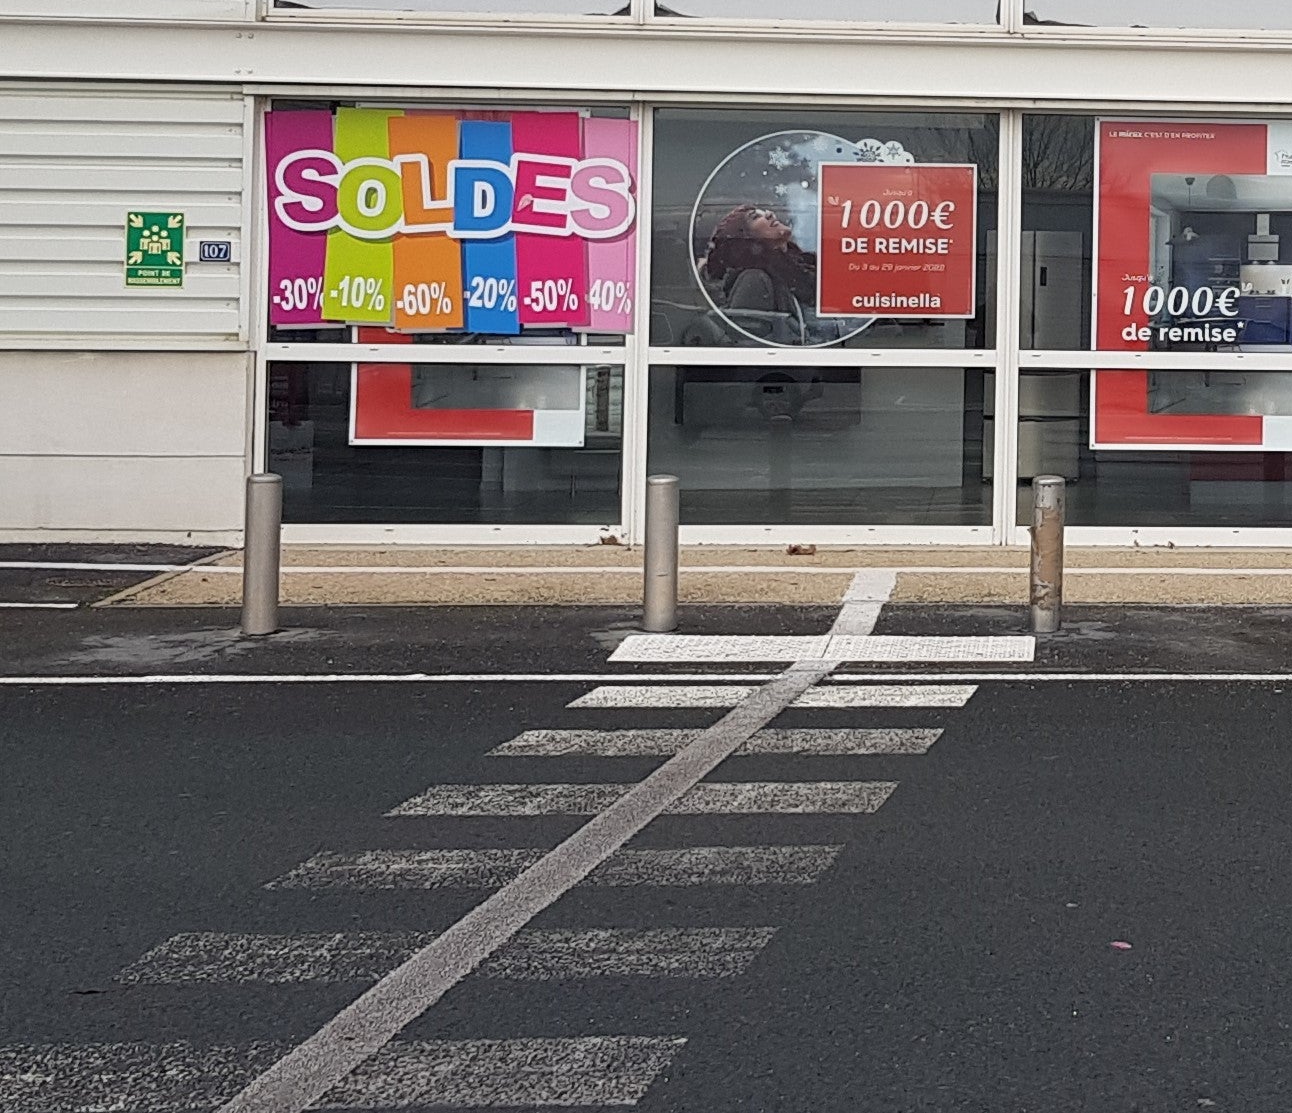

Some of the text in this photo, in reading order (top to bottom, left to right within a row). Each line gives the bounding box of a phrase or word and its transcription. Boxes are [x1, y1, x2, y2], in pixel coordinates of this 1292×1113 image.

[274, 149, 636, 239] SOLDES
[203, 244, 227, 258] 107
[841, 237, 869, 254] DE
[273, 277, 324, 311] -30%
[330, 275, 385, 312] -10%
[397, 281, 452, 316] -60%
[463, 276, 517, 312] -20%
[523, 278, 579, 312] -50%
[852, 292, 942, 308] cuisinella
[1121, 322, 1153, 341] de
